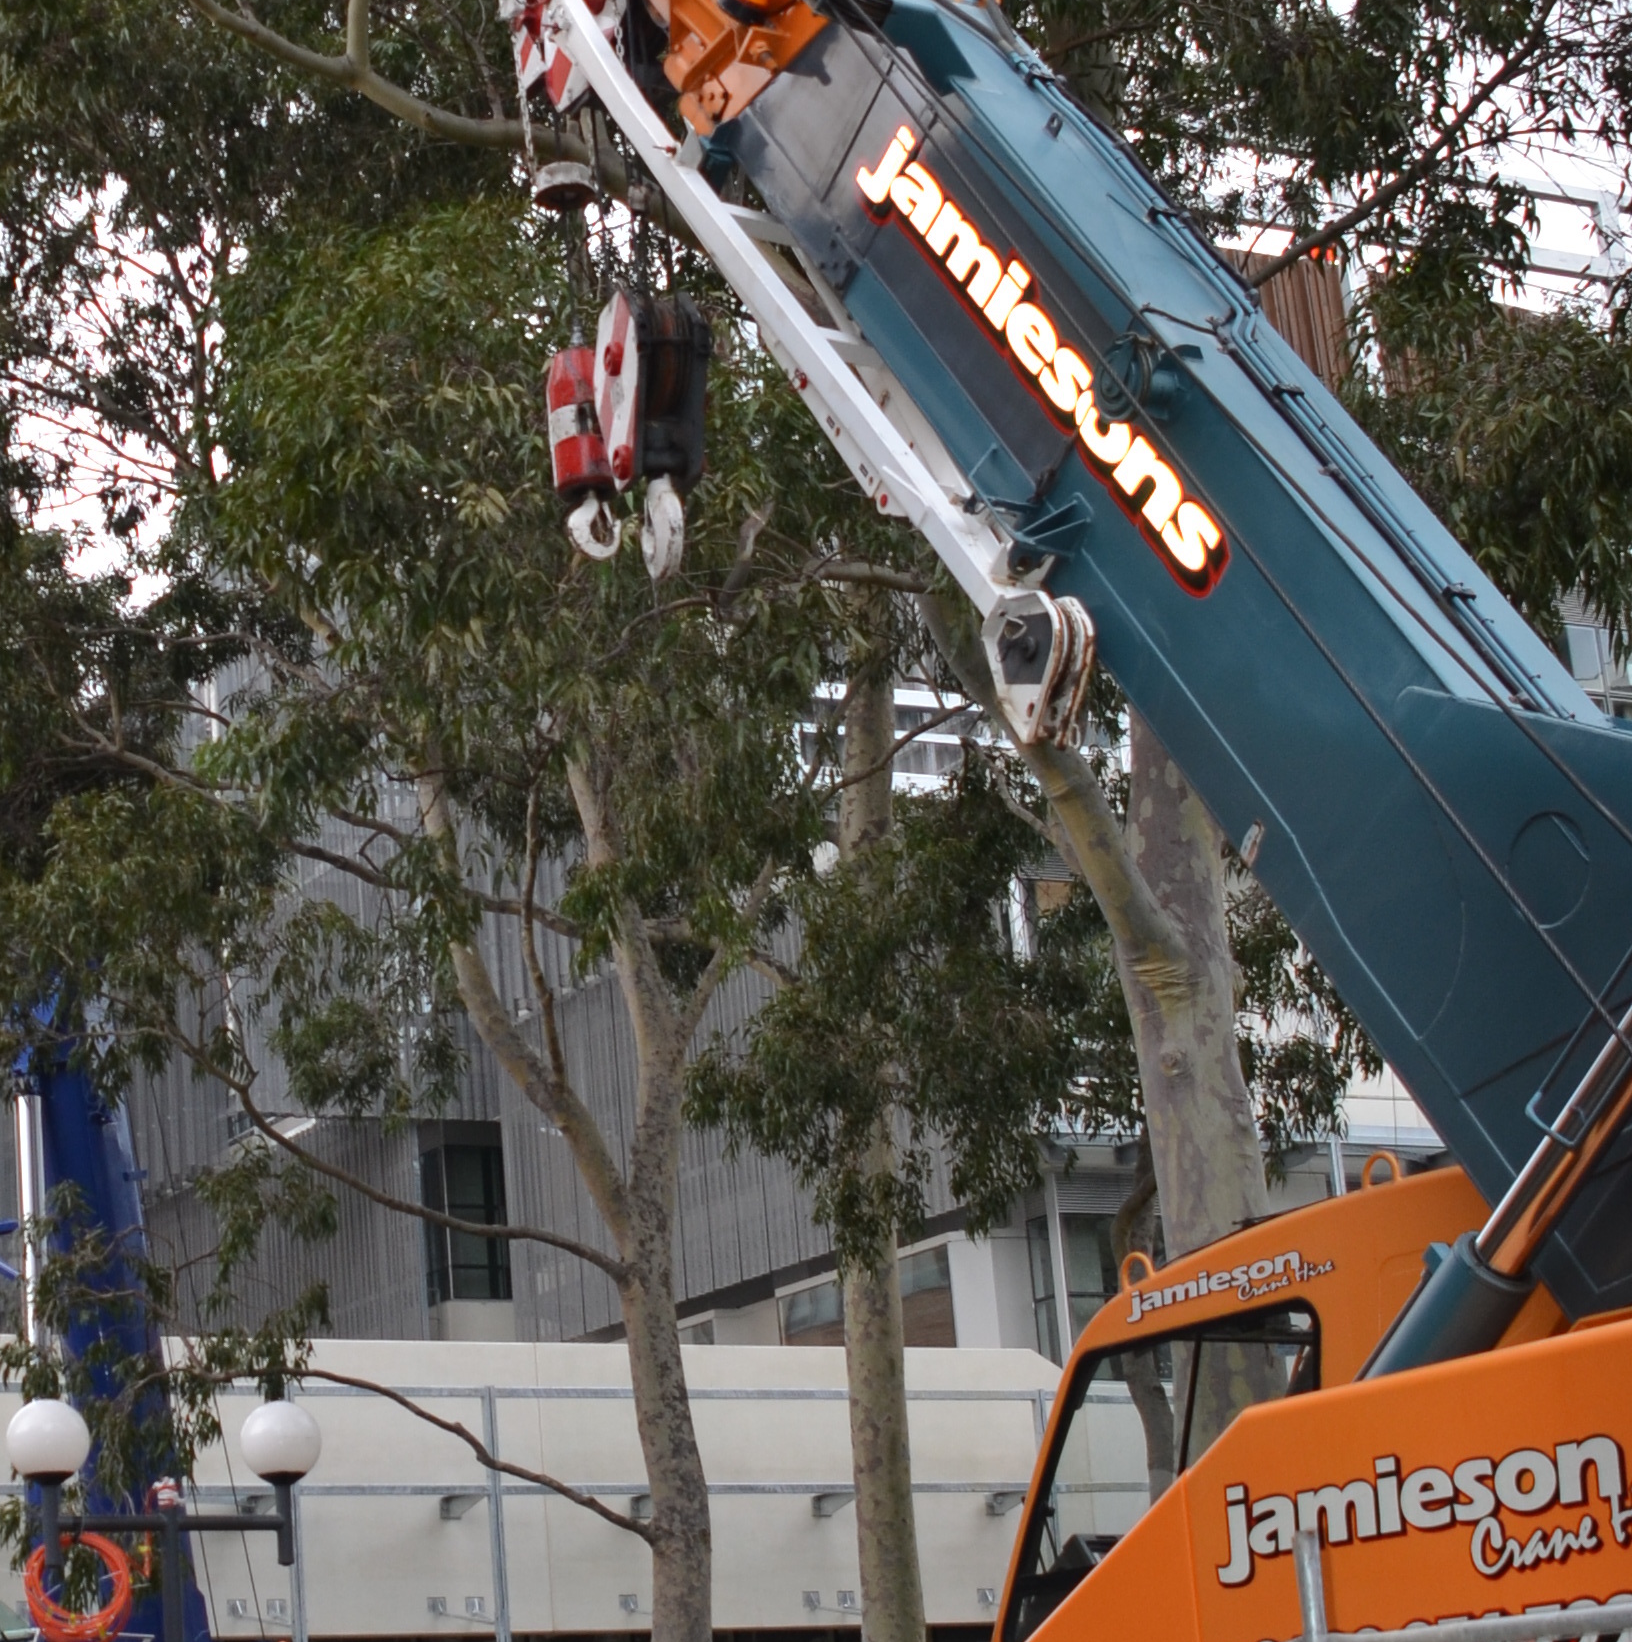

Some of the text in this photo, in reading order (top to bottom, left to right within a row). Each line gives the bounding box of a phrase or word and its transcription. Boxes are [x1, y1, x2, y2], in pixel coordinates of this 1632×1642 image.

[856, 124, 1228, 582] jamiesons
[1125, 1250, 1303, 1324] jamieson
[1236, 1276, 1290, 1303] Crane
[1216, 1435, 1626, 1587] jamieson
[1470, 1514, 1602, 1579] Crane
